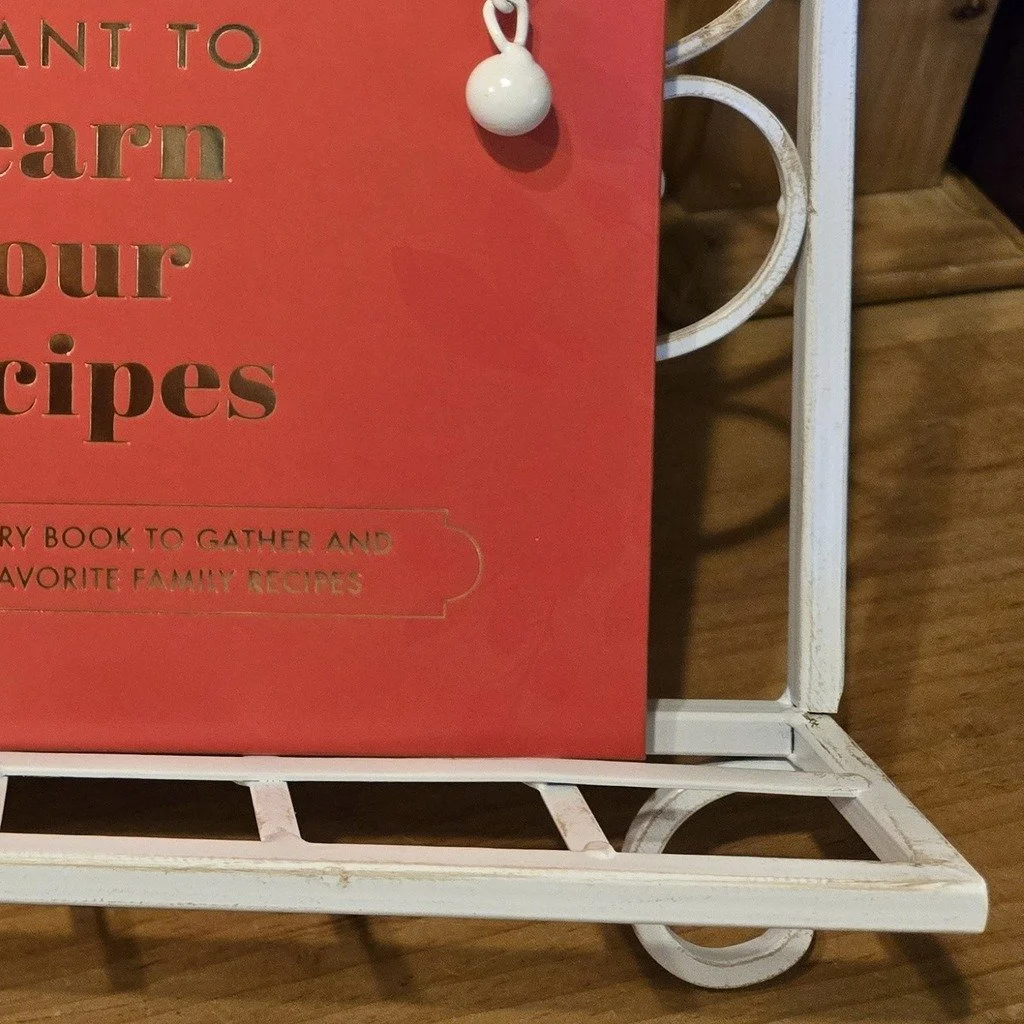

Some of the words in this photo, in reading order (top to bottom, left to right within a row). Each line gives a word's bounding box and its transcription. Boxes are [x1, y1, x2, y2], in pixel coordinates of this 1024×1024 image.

[167, 21, 262, 71] TO
[43, 525, 134, 553] BOOK
[144, 527, 185, 552] TO
[196, 528, 313, 555] GATHER
[324, 530, 395, 556] AND
[132, 567, 234, 594] FAMILY
[246, 569, 366, 595] RECIPES
